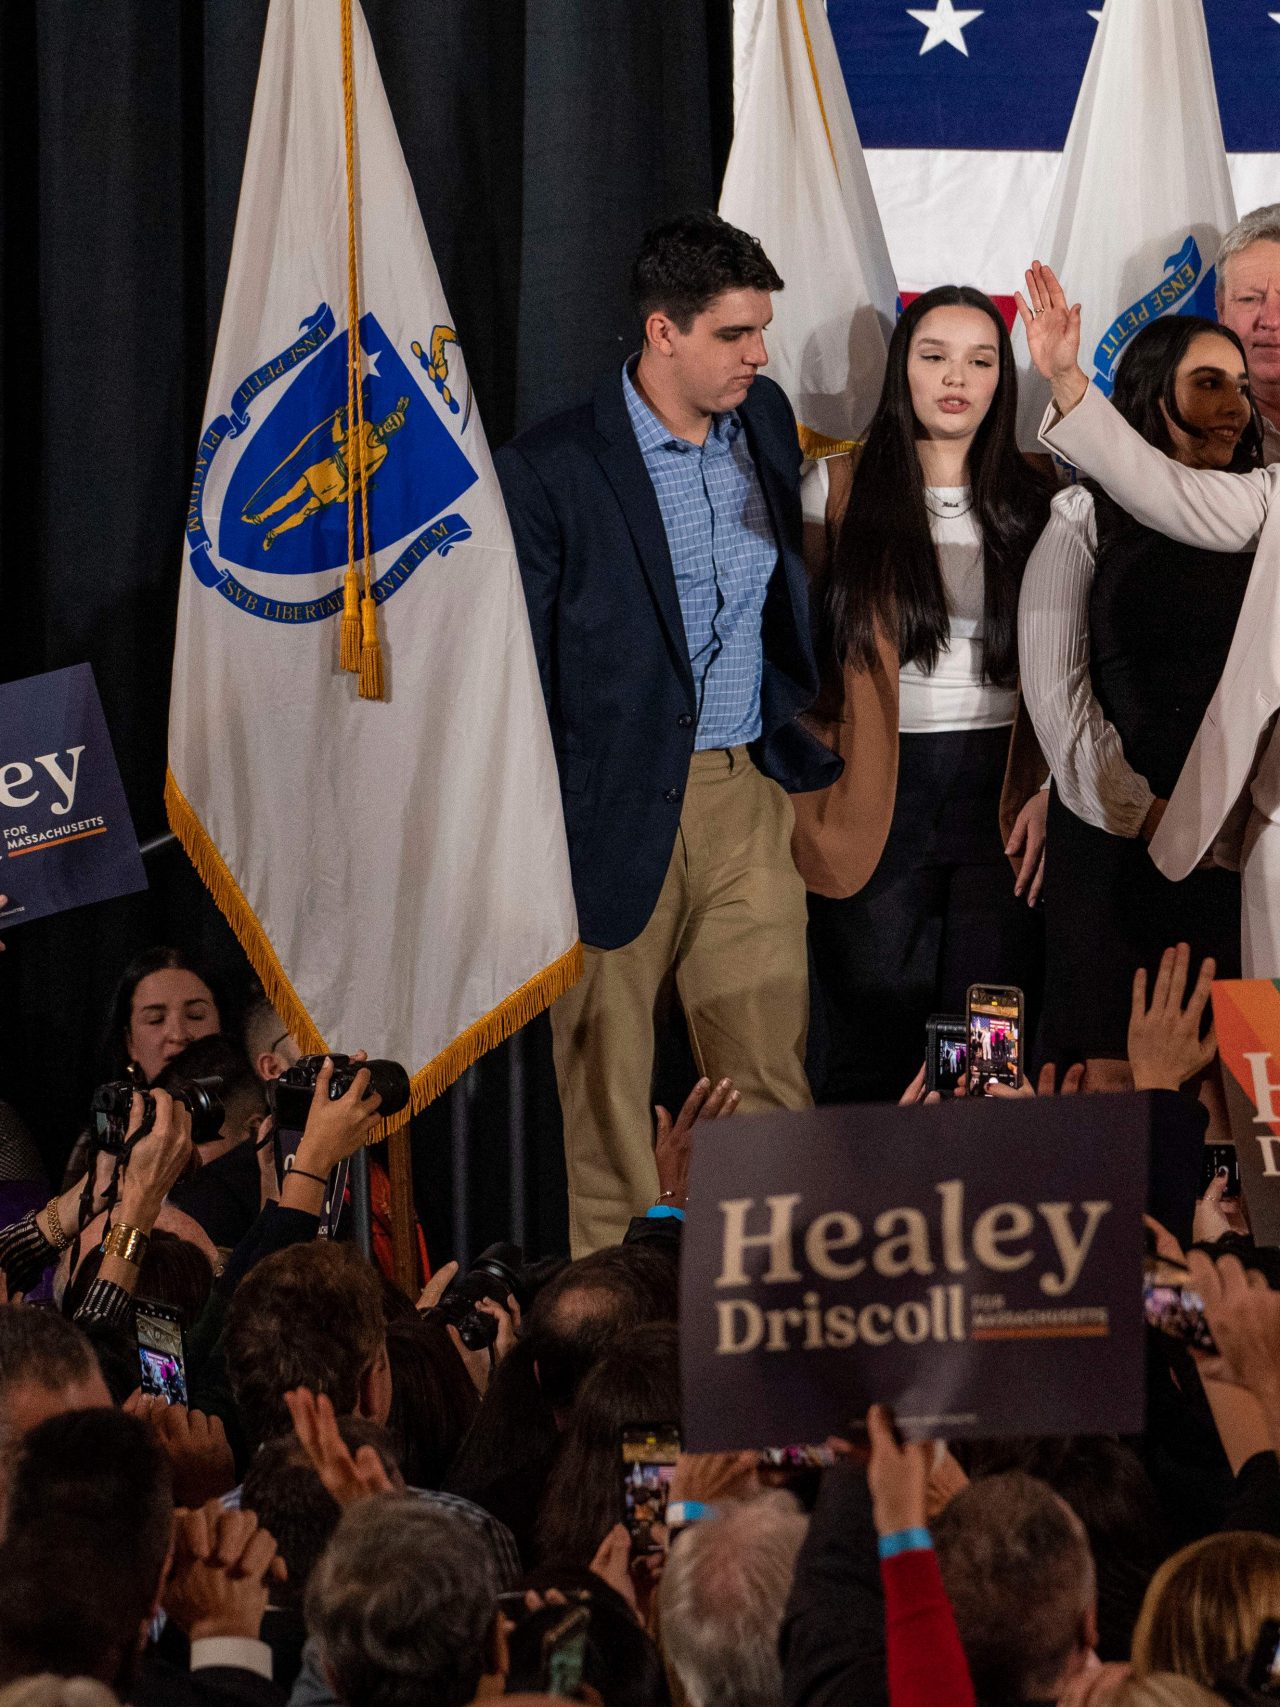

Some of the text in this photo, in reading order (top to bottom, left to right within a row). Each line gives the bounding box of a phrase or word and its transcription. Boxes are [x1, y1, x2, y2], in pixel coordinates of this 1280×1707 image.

[1101, 263, 1196, 359] ENSE PETIT
[240, 326, 327, 403] ENSE PETIT
[187, 430, 221, 533] PLACIDAM
[223, 580, 258, 610] SVB
[263, 592, 344, 620] LIBERTAT
[3, 825, 28, 839] FOR
[7, 815, 104, 850] MASSACHUSETTS
[713, 1178, 1113, 1296] Healey
[714, 1284, 967, 1355] Driscoll
